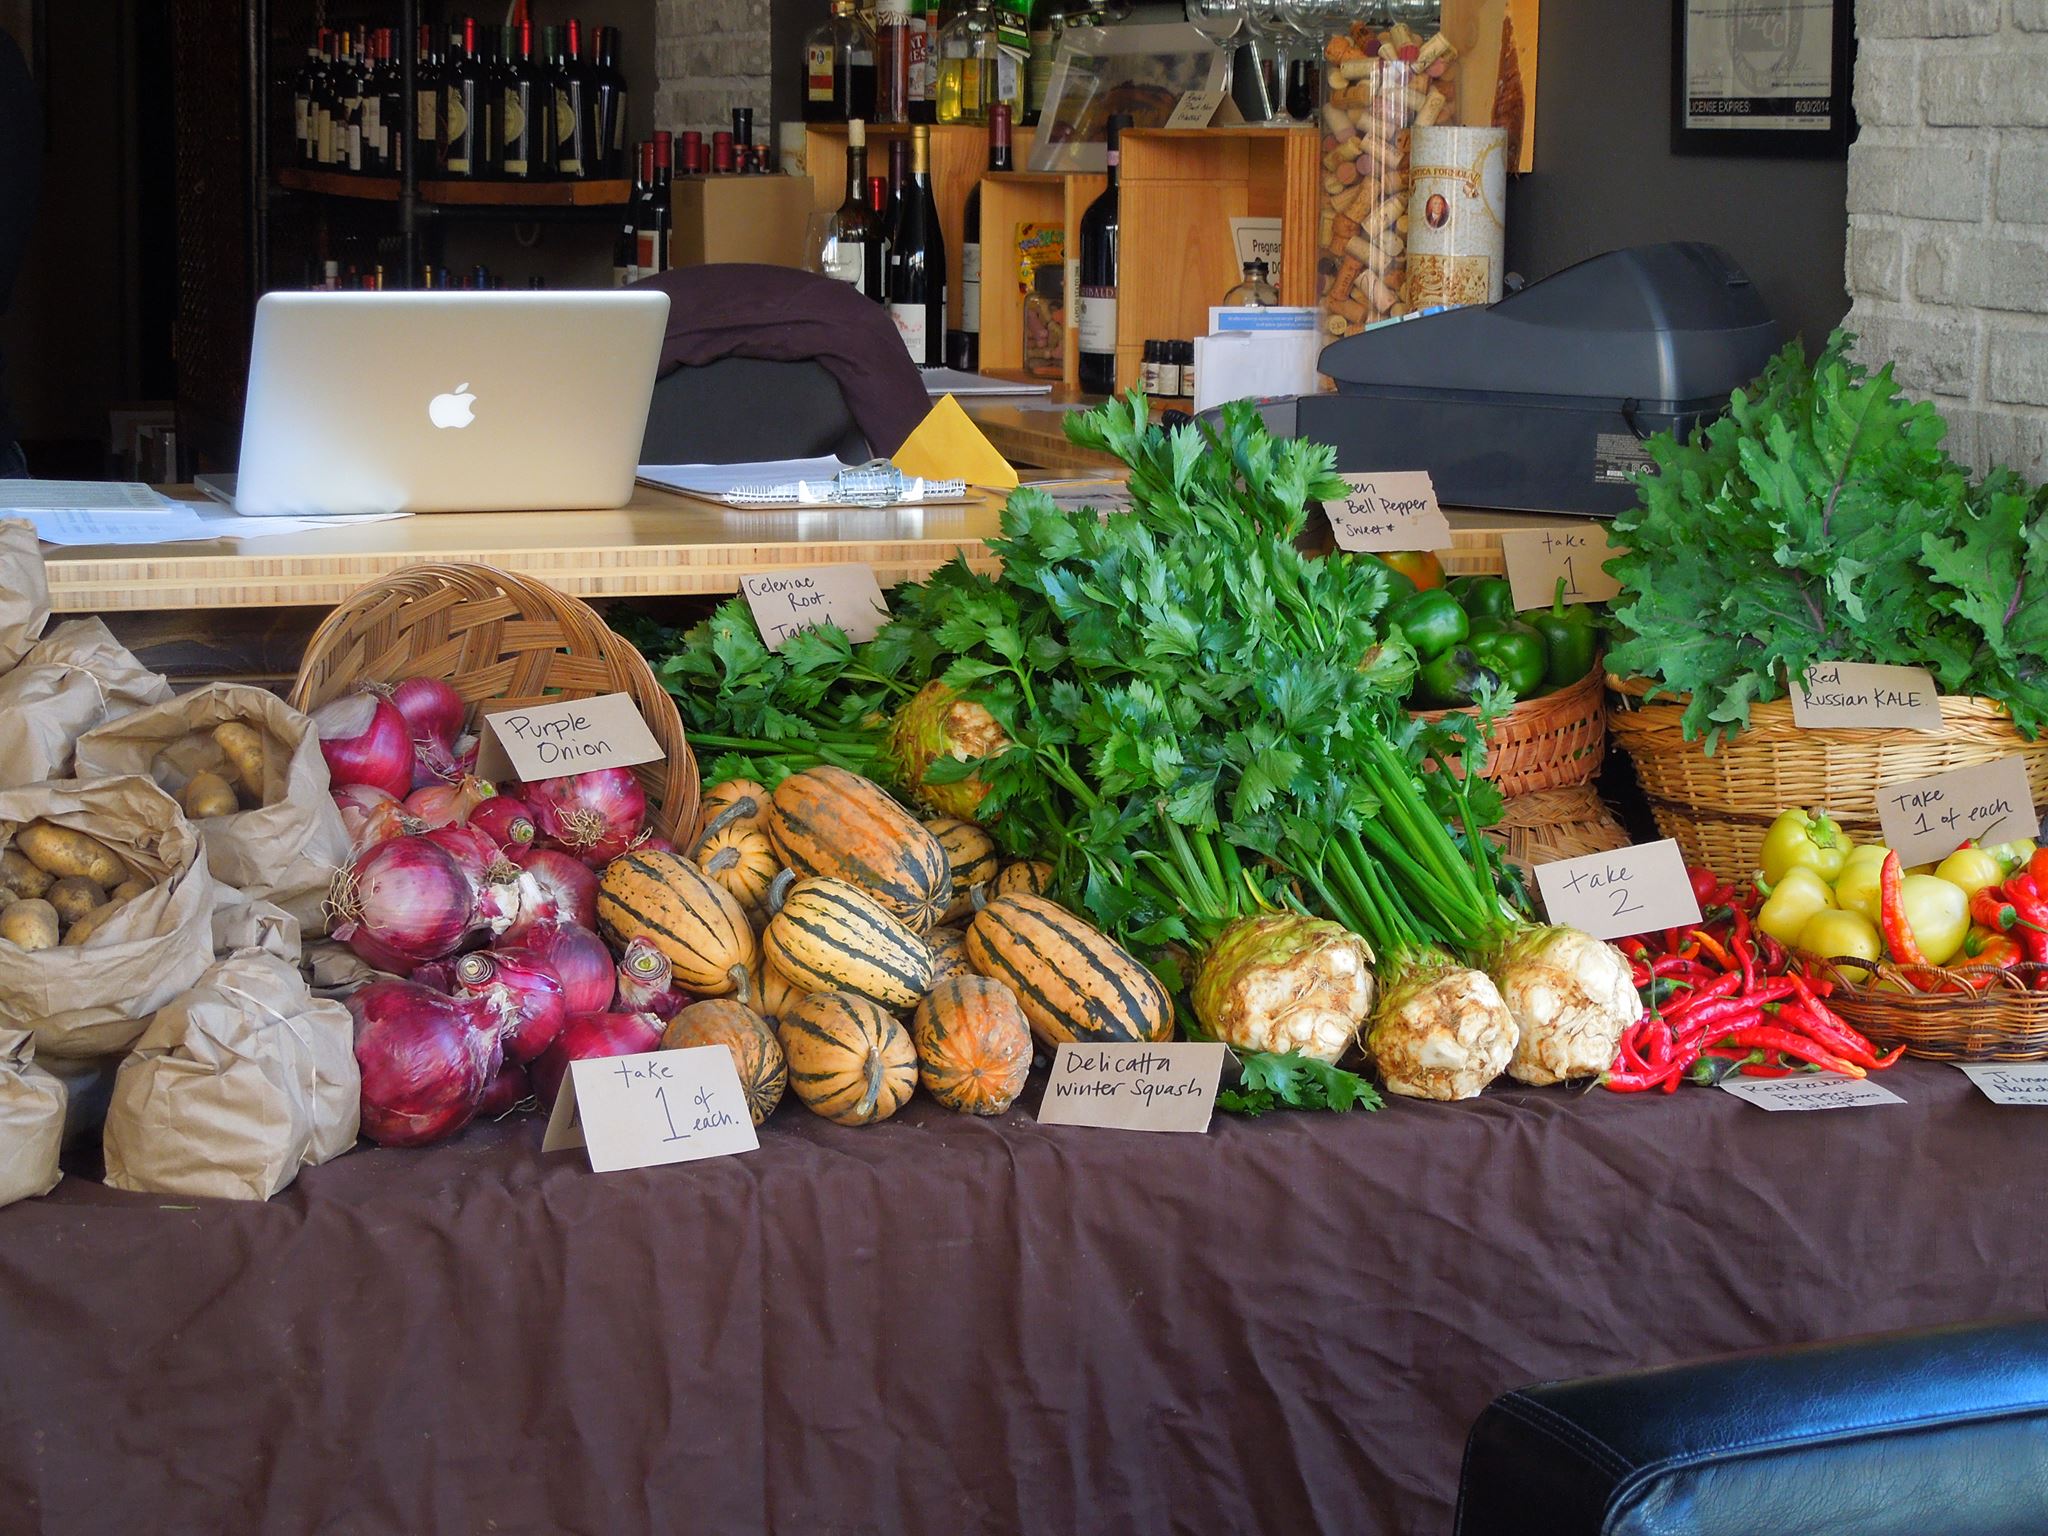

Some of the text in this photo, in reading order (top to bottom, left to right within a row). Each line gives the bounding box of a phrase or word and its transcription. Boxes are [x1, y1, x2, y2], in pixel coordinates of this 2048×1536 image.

[1689, 101, 1718, 113] LICENSE
[1345, 498, 1428, 516] Bell Pepper
[1542, 532, 1587, 554] take
[749, 576, 814, 597] Celeriac
[1563, 555, 1584, 595] 1
[1807, 666, 1841, 686] Red
[1803, 690, 1868, 709] Russian
[505, 712, 591, 740] Purple
[537, 738, 612, 764] Onion
[1891, 789, 1945, 812] Take
[1913, 798, 2014, 836] 1 of each
[1562, 865, 1634, 894] take
[1608, 888, 1644, 917] 2
[614, 1060, 674, 1088] take
[1130, 1078, 1203, 1107] Squash
[1740, 1083, 1786, 1093] Red
[655, 1086, 715, 1143] 1 of
